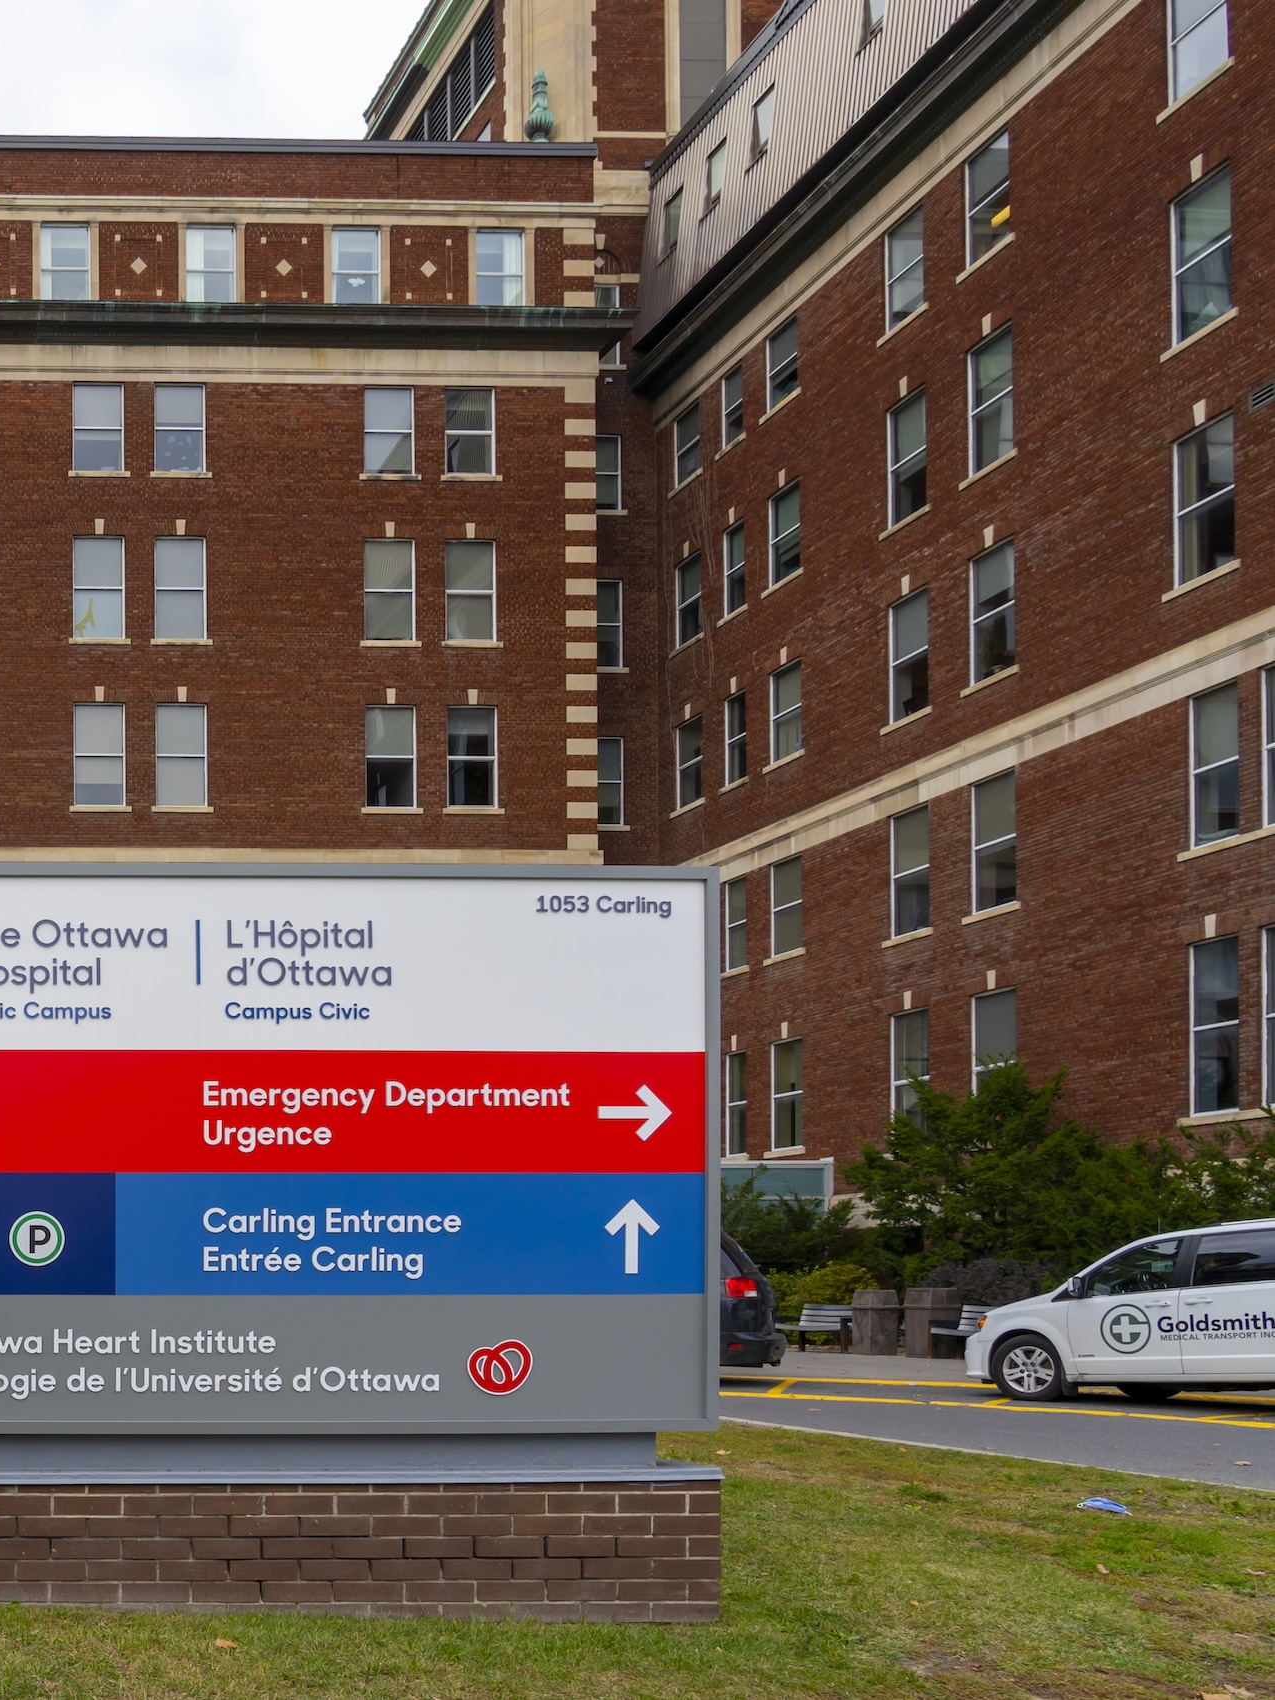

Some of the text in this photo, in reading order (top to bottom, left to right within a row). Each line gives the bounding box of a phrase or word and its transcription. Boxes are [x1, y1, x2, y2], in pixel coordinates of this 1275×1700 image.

[536, 895, 672, 919] 1053 Carling
[31, 918, 168, 949] Ottawa
[226, 919, 374, 957] L'Hôpital
[226, 957, 392, 986] d'Ottawa
[23, 1001, 112, 1025] Campus
[224, 1001, 370, 1025] Campus Civic
[202, 1080, 571, 1115] Emergency Department
[202, 1119, 333, 1154] Urgence
[202, 1207, 462, 1240] Carling Entrance
[29, 1224, 51, 1254] P
[202, 1245, 424, 1280] Entrée Carling
[1157, 1311, 1275, 1333] Goldsmith
[53, 1328, 140, 1356] Heart
[150, 1328, 277, 1355] Institute
[1160, 1334, 1200, 1342] MEDICAL
[1201, 1332, 1258, 1340] TRANSPORT
[66, 1366, 105, 1394] de
[115, 1366, 283, 1394] l'Université
[292, 1366, 440, 1394] d'Ottawa
